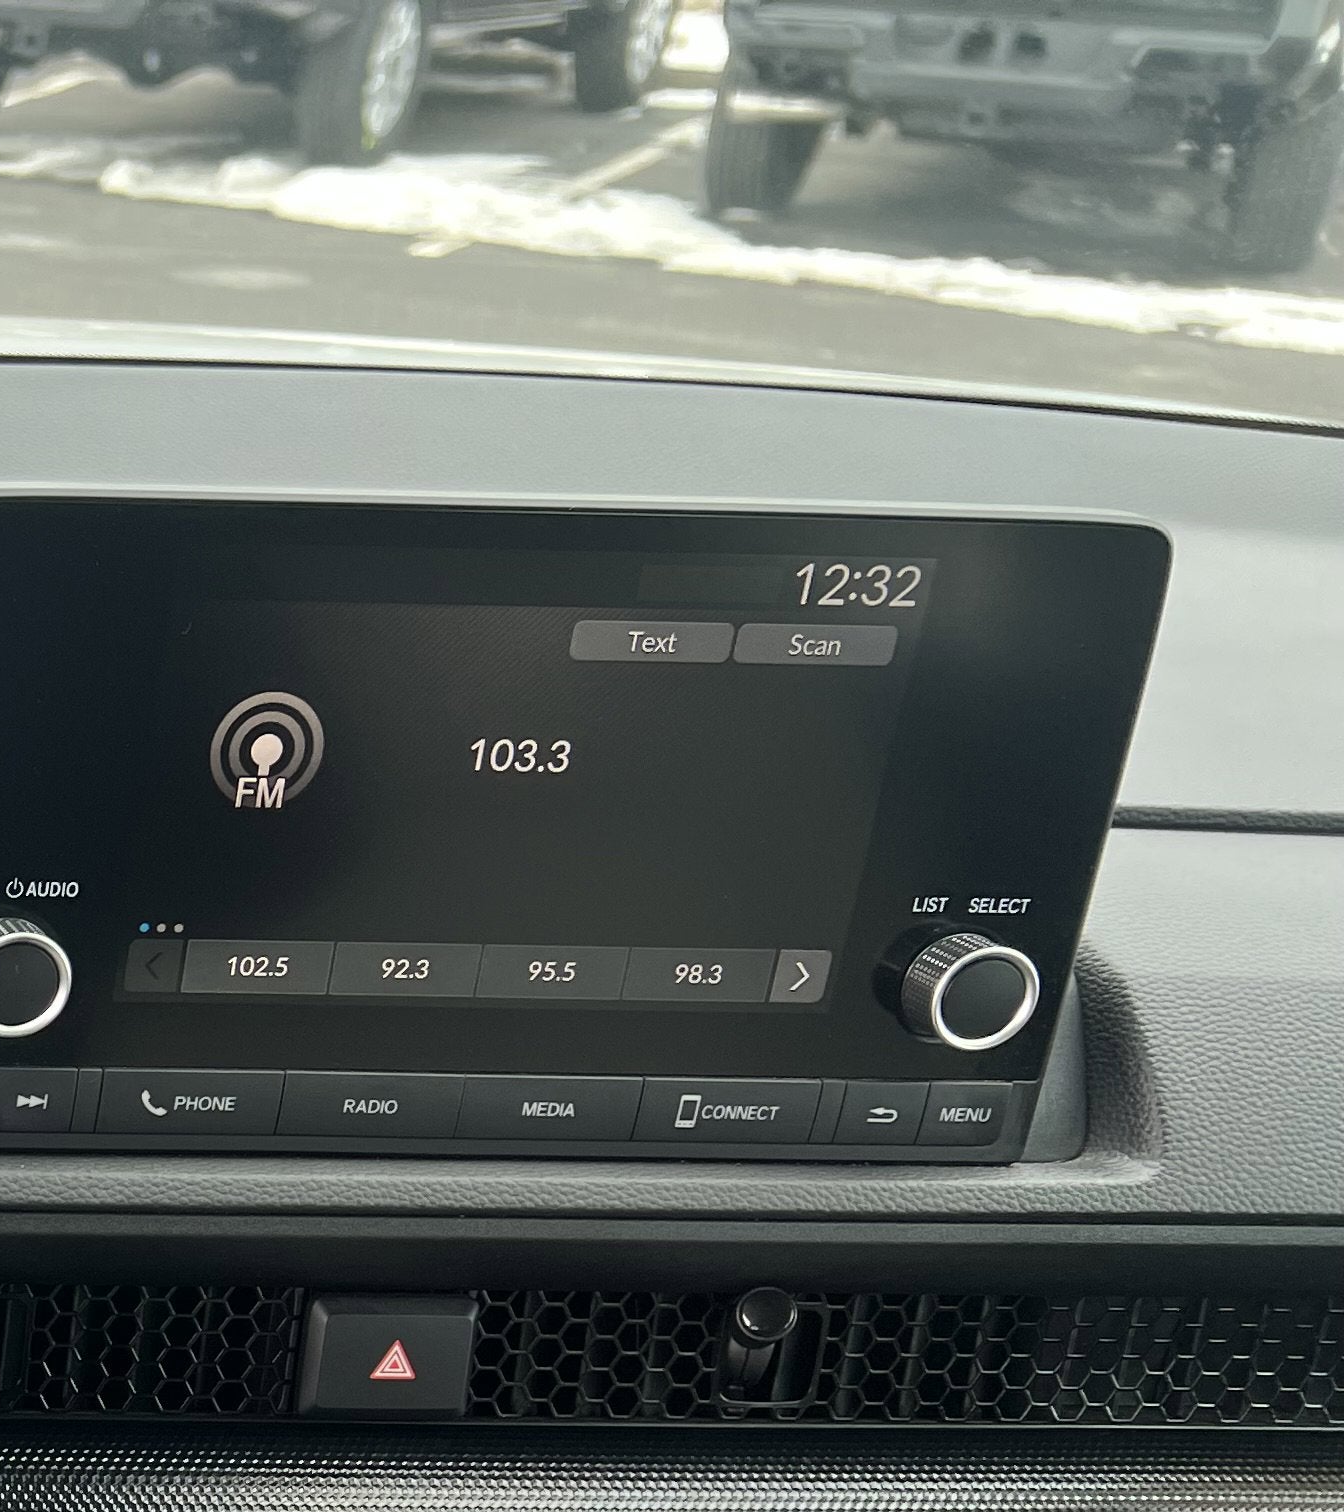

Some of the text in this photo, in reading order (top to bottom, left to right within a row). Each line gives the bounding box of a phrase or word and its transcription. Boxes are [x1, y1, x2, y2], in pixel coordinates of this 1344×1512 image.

[795, 562, 922, 608] 12:32
[628, 631, 678, 655] Text
[788, 634, 841, 657] Scan
[469, 738, 572, 774] 103.3
[234, 777, 286, 809] FM
[26, 880, 79, 899] AUDIO
[913, 897, 949, 914] LIST
[968, 897, 1031, 915] SELECT
[226, 955, 289, 979] 102.5
[380, 958, 431, 981] 92.3
[527, 961, 577, 982] 95.5
[674, 964, 724, 986] 98.3
[174, 1095, 236, 1113] PHONE
[342, 1099, 399, 1116] RADIO
[521, 1102, 575, 1118] MEDIA
[701, 1105, 780, 1122] CONNECT
[939, 1107, 992, 1123] MENU
